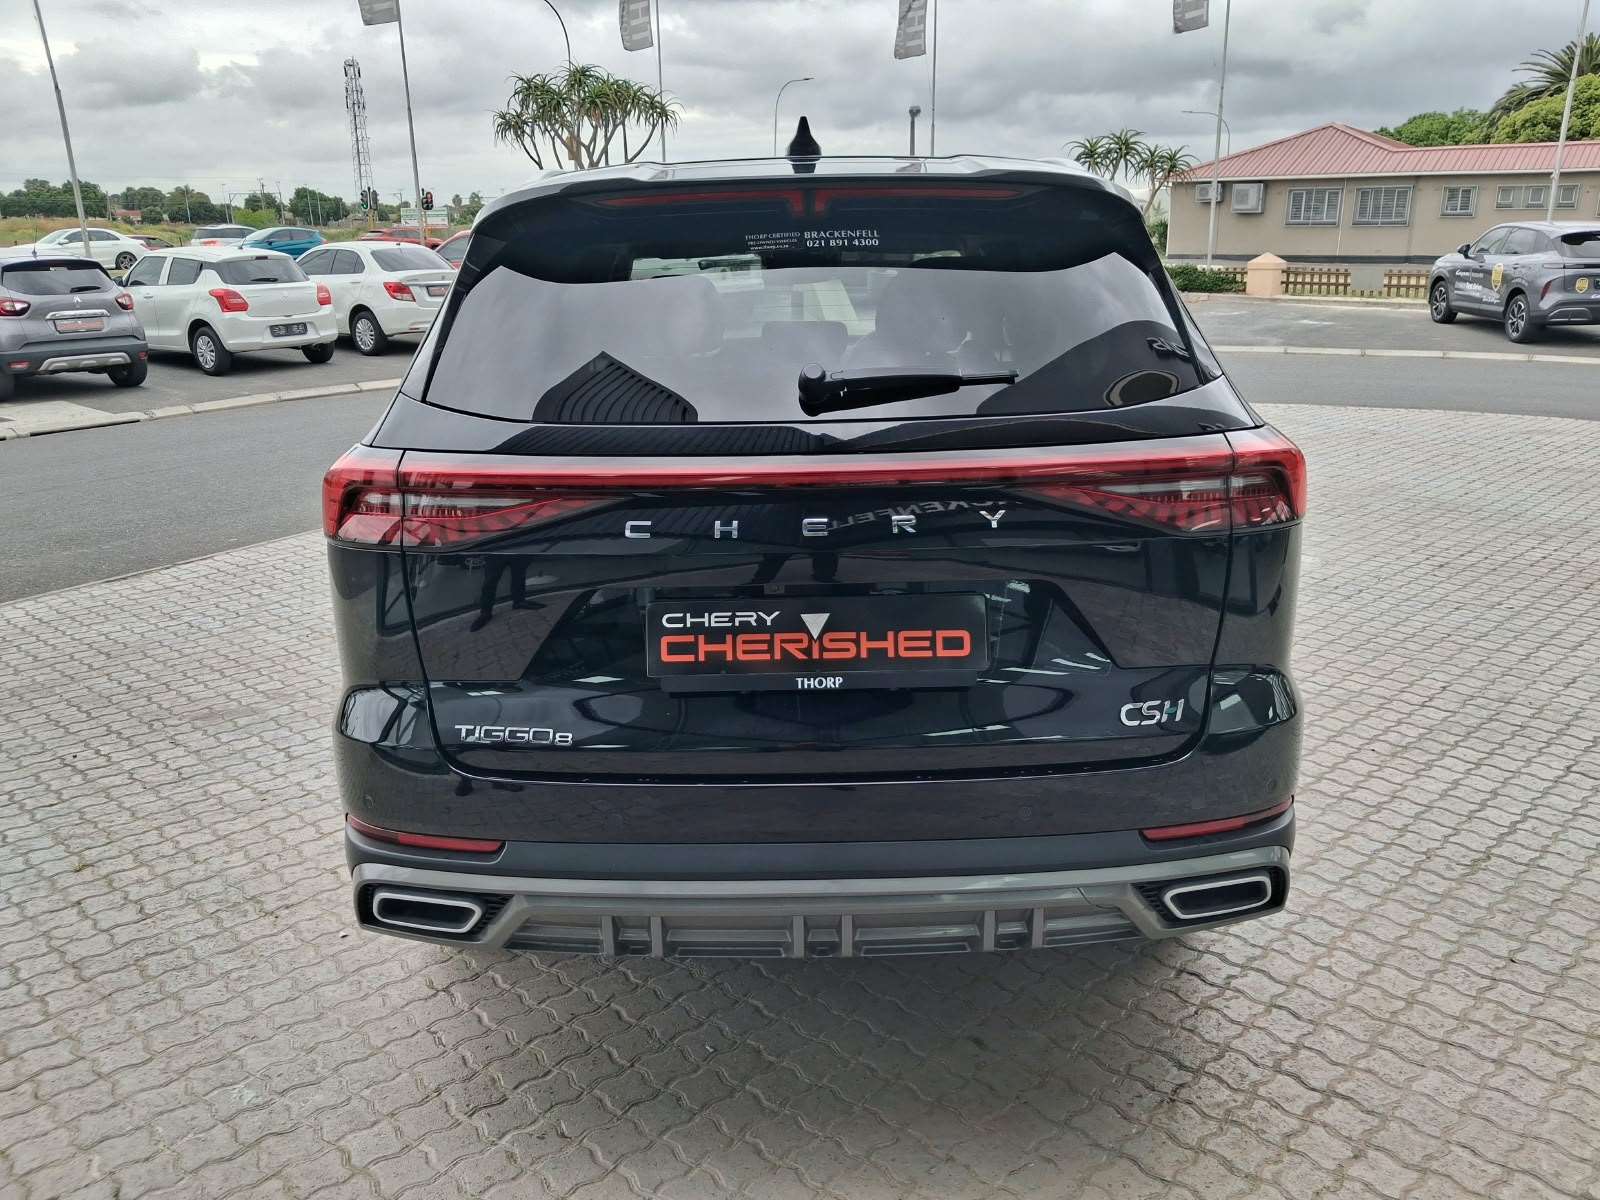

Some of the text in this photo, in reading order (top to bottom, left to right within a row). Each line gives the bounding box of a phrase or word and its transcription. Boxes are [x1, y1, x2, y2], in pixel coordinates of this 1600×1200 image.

[804, 230, 880, 239] BRACKENFELL
[829, 239, 848, 247] 891
[853, 238, 879, 246] 4300
[624, 505, 1006, 538] CHERY
[661, 611, 781, 628] CHERY
[660, 630, 971, 662] CHERISHED
[796, 677, 843, 689] THORP
[1120, 699, 1185, 726] CSH
